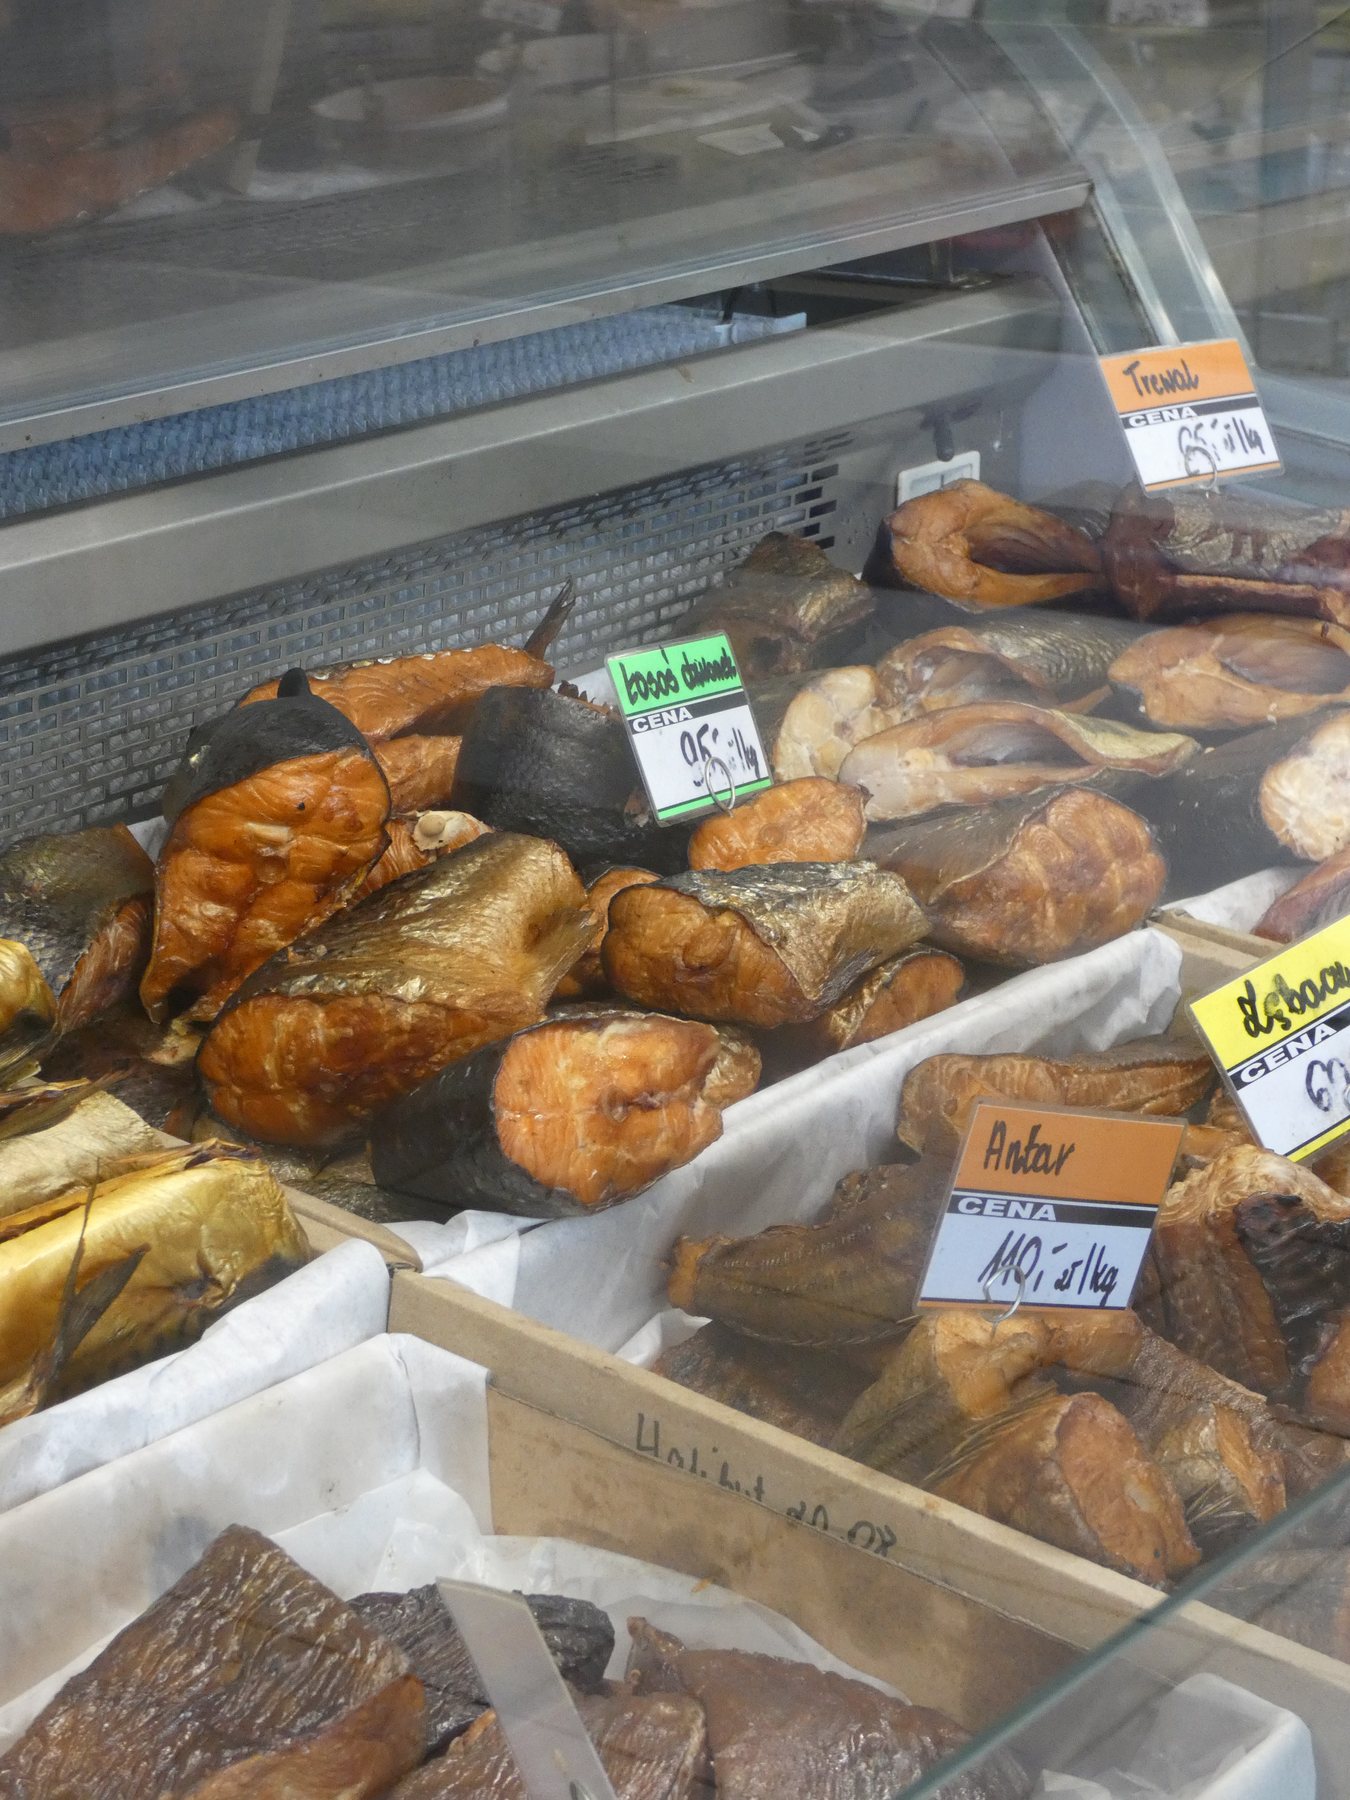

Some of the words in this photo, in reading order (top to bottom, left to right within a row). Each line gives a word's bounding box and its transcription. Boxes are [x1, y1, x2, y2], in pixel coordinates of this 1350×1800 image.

[1129, 406, 1198, 428] CENA
[632, 707, 694, 732] CENA
[1241, 1022, 1337, 1084] CENA
[983, 1120, 1075, 1176] Antar
[957, 1198, 1056, 1222] CENA
